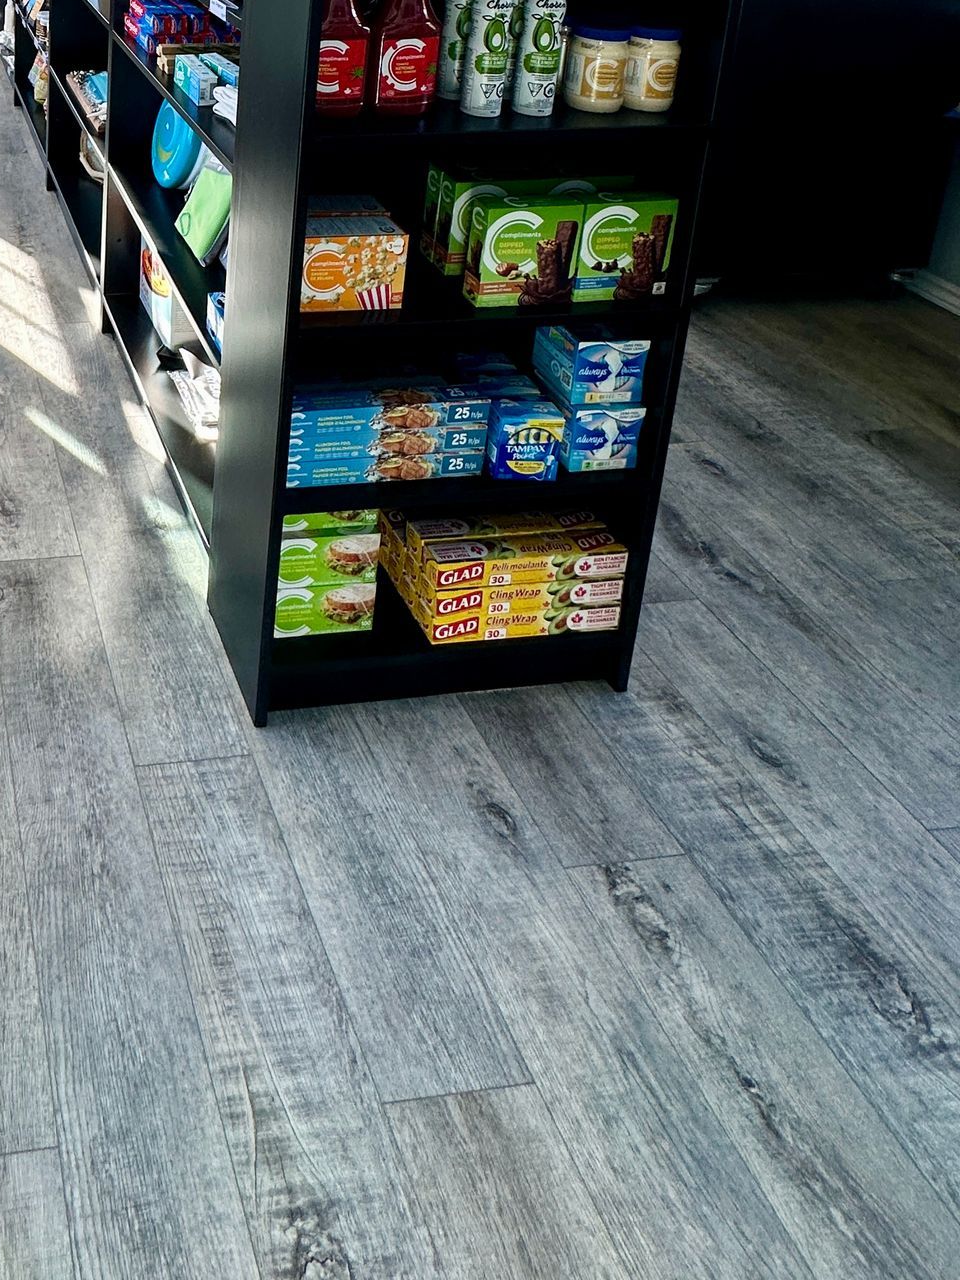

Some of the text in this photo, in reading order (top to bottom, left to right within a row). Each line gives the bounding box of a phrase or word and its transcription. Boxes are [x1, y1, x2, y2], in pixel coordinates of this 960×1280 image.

[578, 367, 608, 378] always
[445, 388, 465, 397] 25
[454, 407, 470, 419] 25
[451, 433, 468, 445] 25
[575, 435, 604, 446] always
[505, 445, 546, 453] TAMPAX
[448, 458, 464, 470] 25
[578, 532, 615, 548] GLAD
[440, 565, 483, 585] GLAD
[491, 576, 504, 584] 30
[438, 594, 481, 614] GLAD
[490, 604, 503, 612] 30
[435, 620, 478, 639] GLAD
[487, 630, 499, 638] 30
